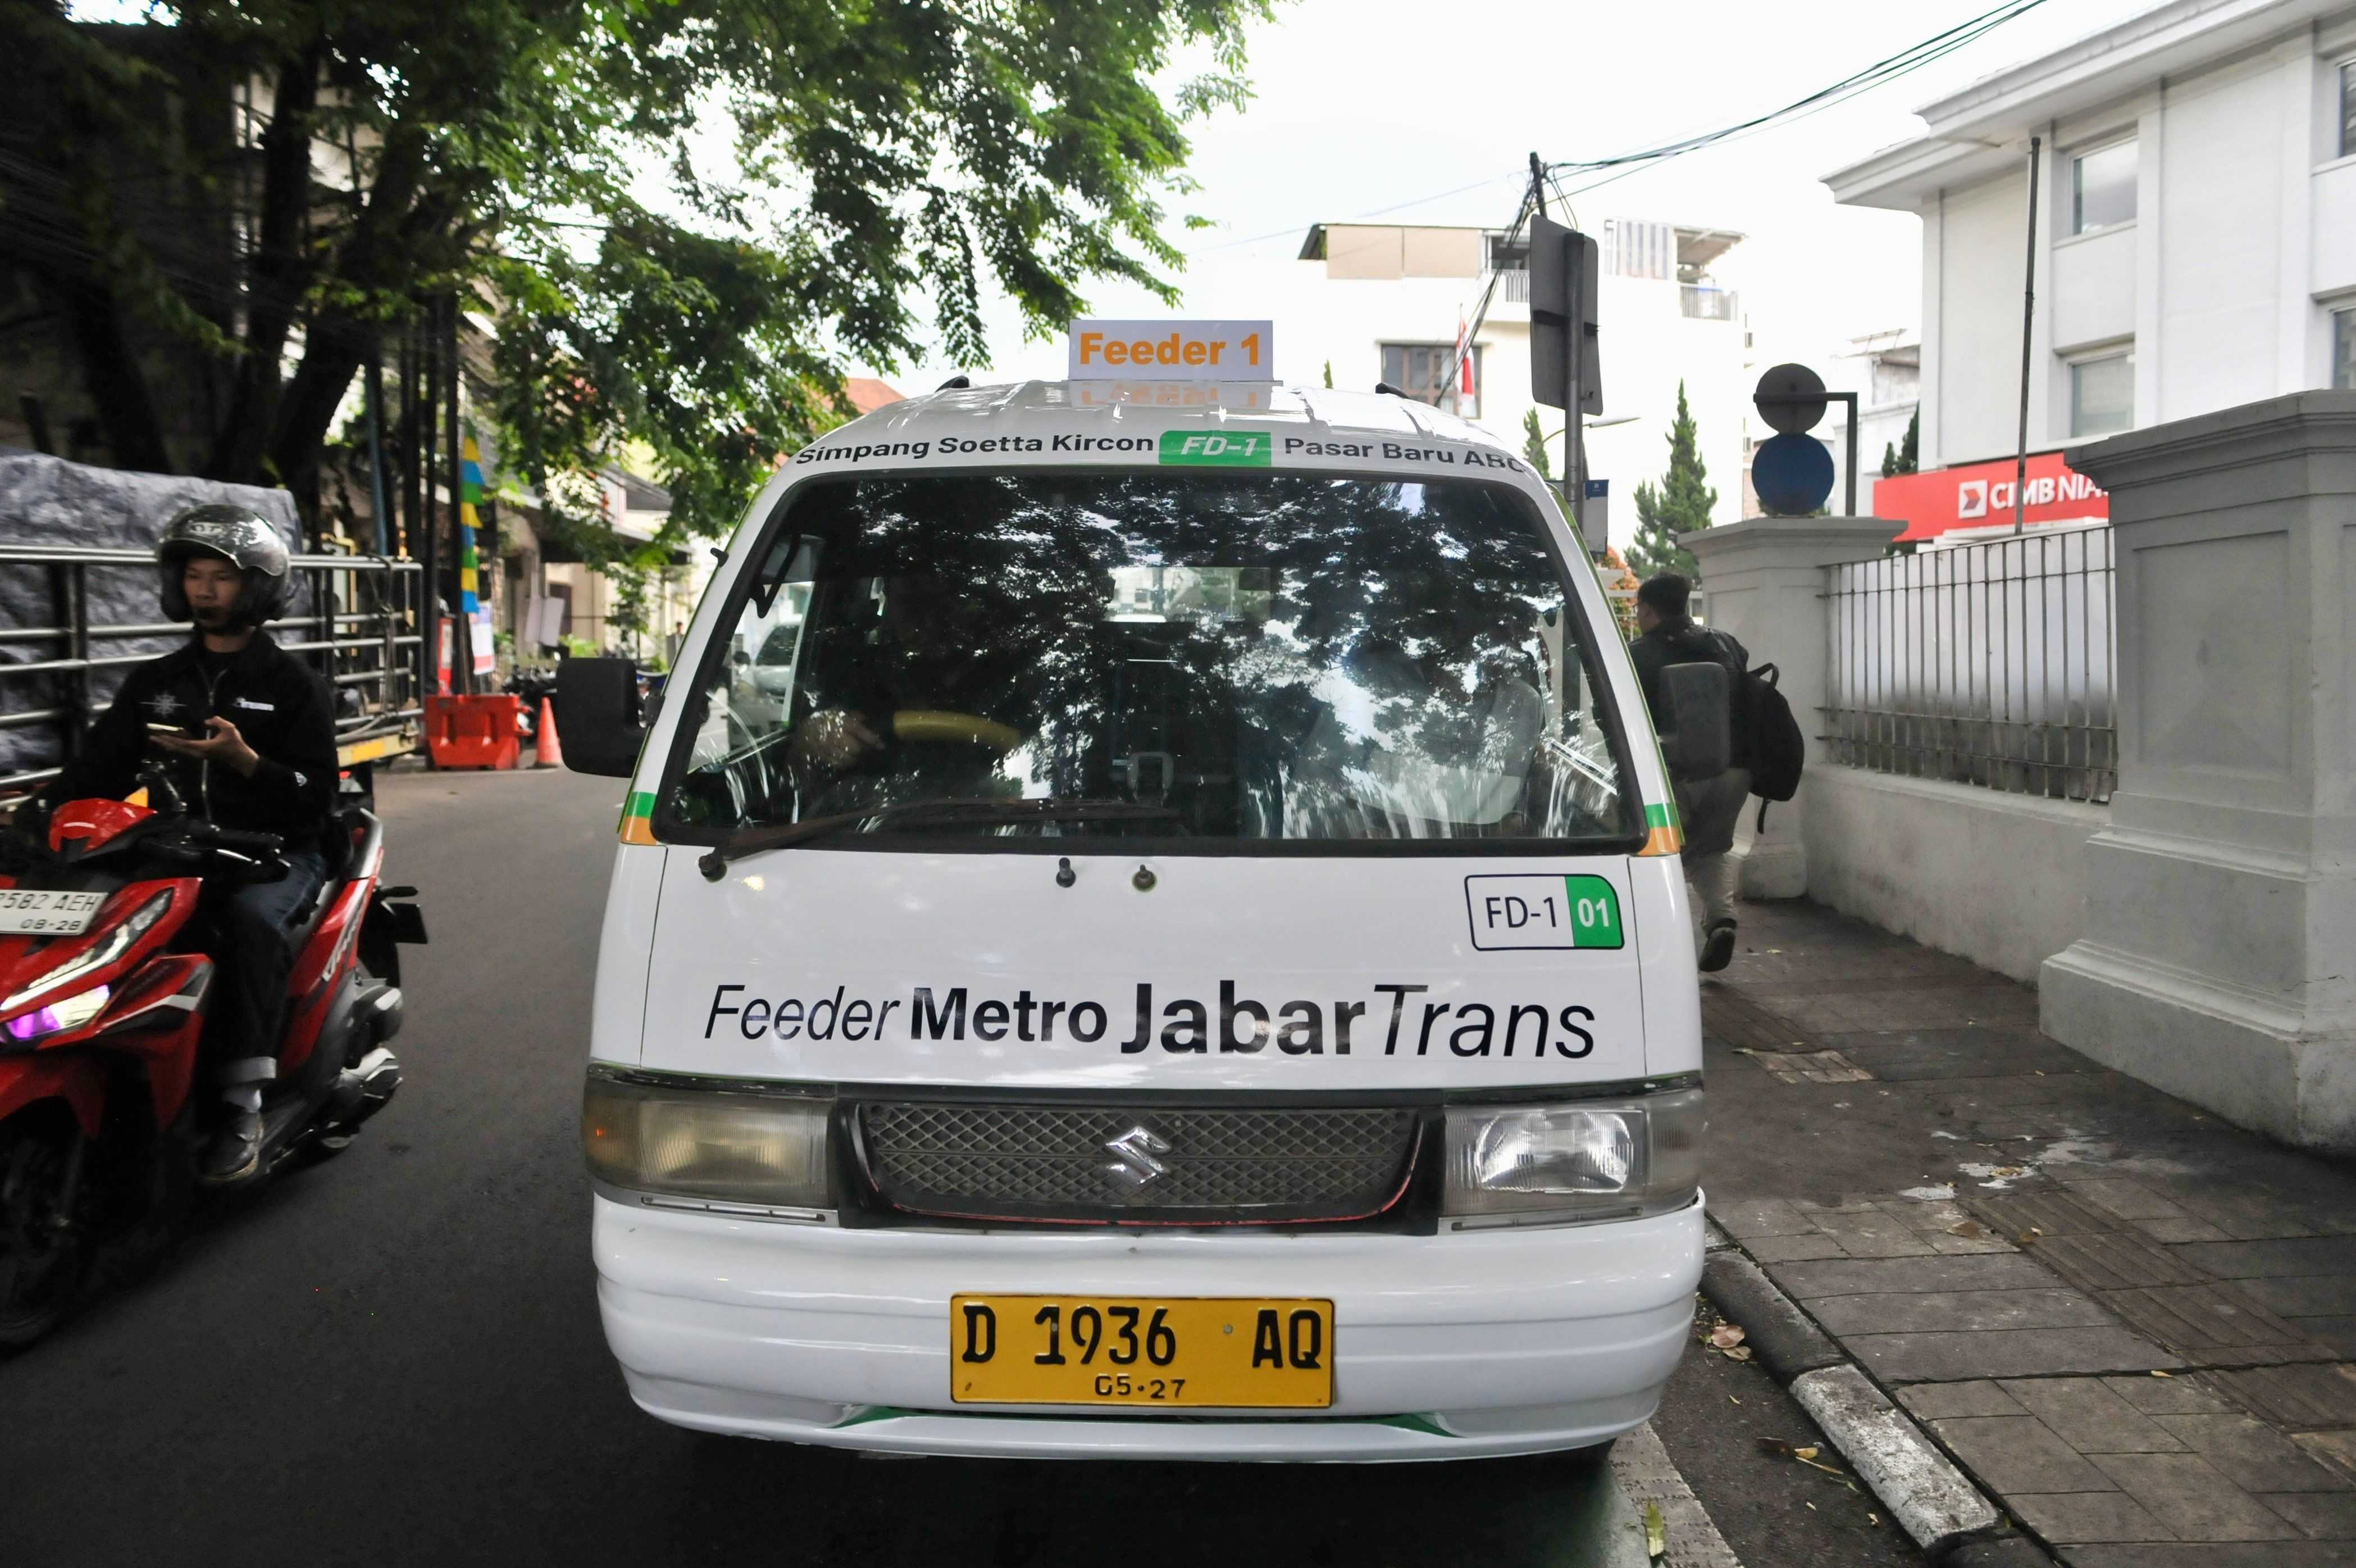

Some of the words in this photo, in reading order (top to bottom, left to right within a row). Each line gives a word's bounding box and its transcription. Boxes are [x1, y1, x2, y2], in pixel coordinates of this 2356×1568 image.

[1079, 332, 1227, 366] Feeder
[1241, 332, 1259, 366] 1
[796, 440, 929, 464] Simpang
[937, 436, 1043, 454] Soetta
[1052, 434, 1154, 451] Kircon
[1181, 436, 1257, 456] FD-1
[1285, 438, 1374, 457] Pasar
[1382, 443, 1455, 463] Baru
[1464, 450, 1526, 473] ABC
[1990, 477, 2055, 509] CIMB
[52, 895, 99, 911] AEH
[1485, 896, 1556, 928] FD-1
[1578, 898, 1610, 927] 01
[704, 984, 901, 1041] Feeder
[910, 987, 1108, 1042] Metro
[962, 1305, 996, 1364] D
[1034, 1305, 1176, 1367] 1936
[1252, 1309, 1321, 1370] AQ
